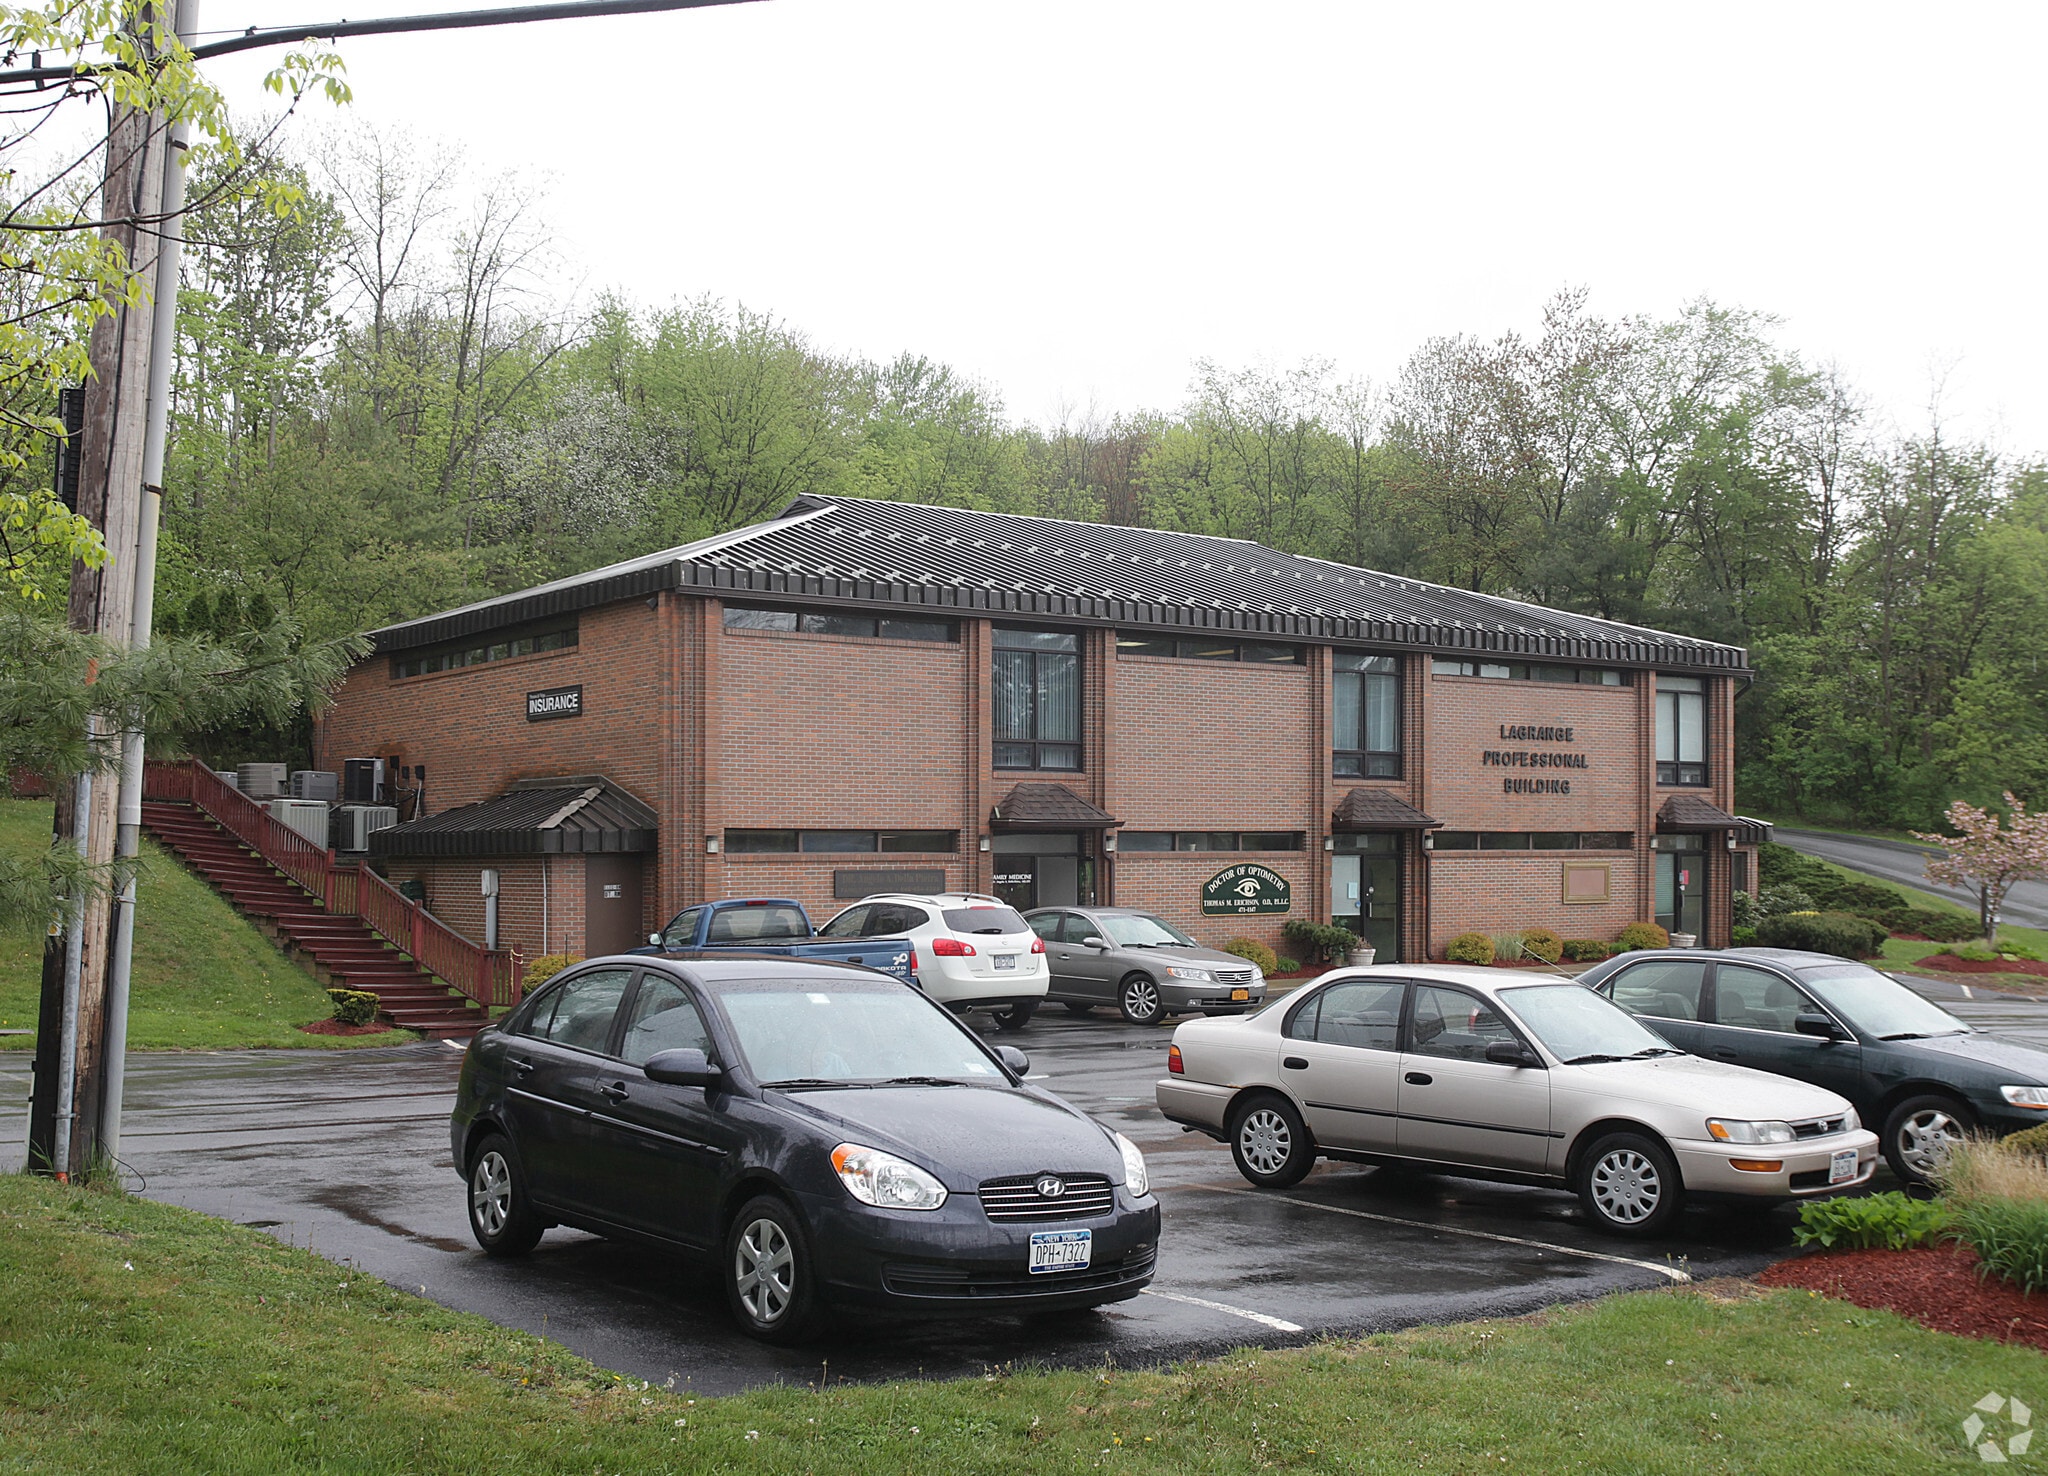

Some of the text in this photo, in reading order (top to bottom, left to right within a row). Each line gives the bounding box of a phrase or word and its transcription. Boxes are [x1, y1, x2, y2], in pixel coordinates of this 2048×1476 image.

[529, 693, 579, 713] INSURANCE
[1500, 724, 1574, 742] LAGRANGE
[1483, 750, 1589, 769] PROFESSIONAL
[1503, 778, 1571, 794] BUILDING
[1208, 866, 1286, 893] DOCTOR OF OPTOMETRY
[1203, 899, 1225, 907] THOMAS
